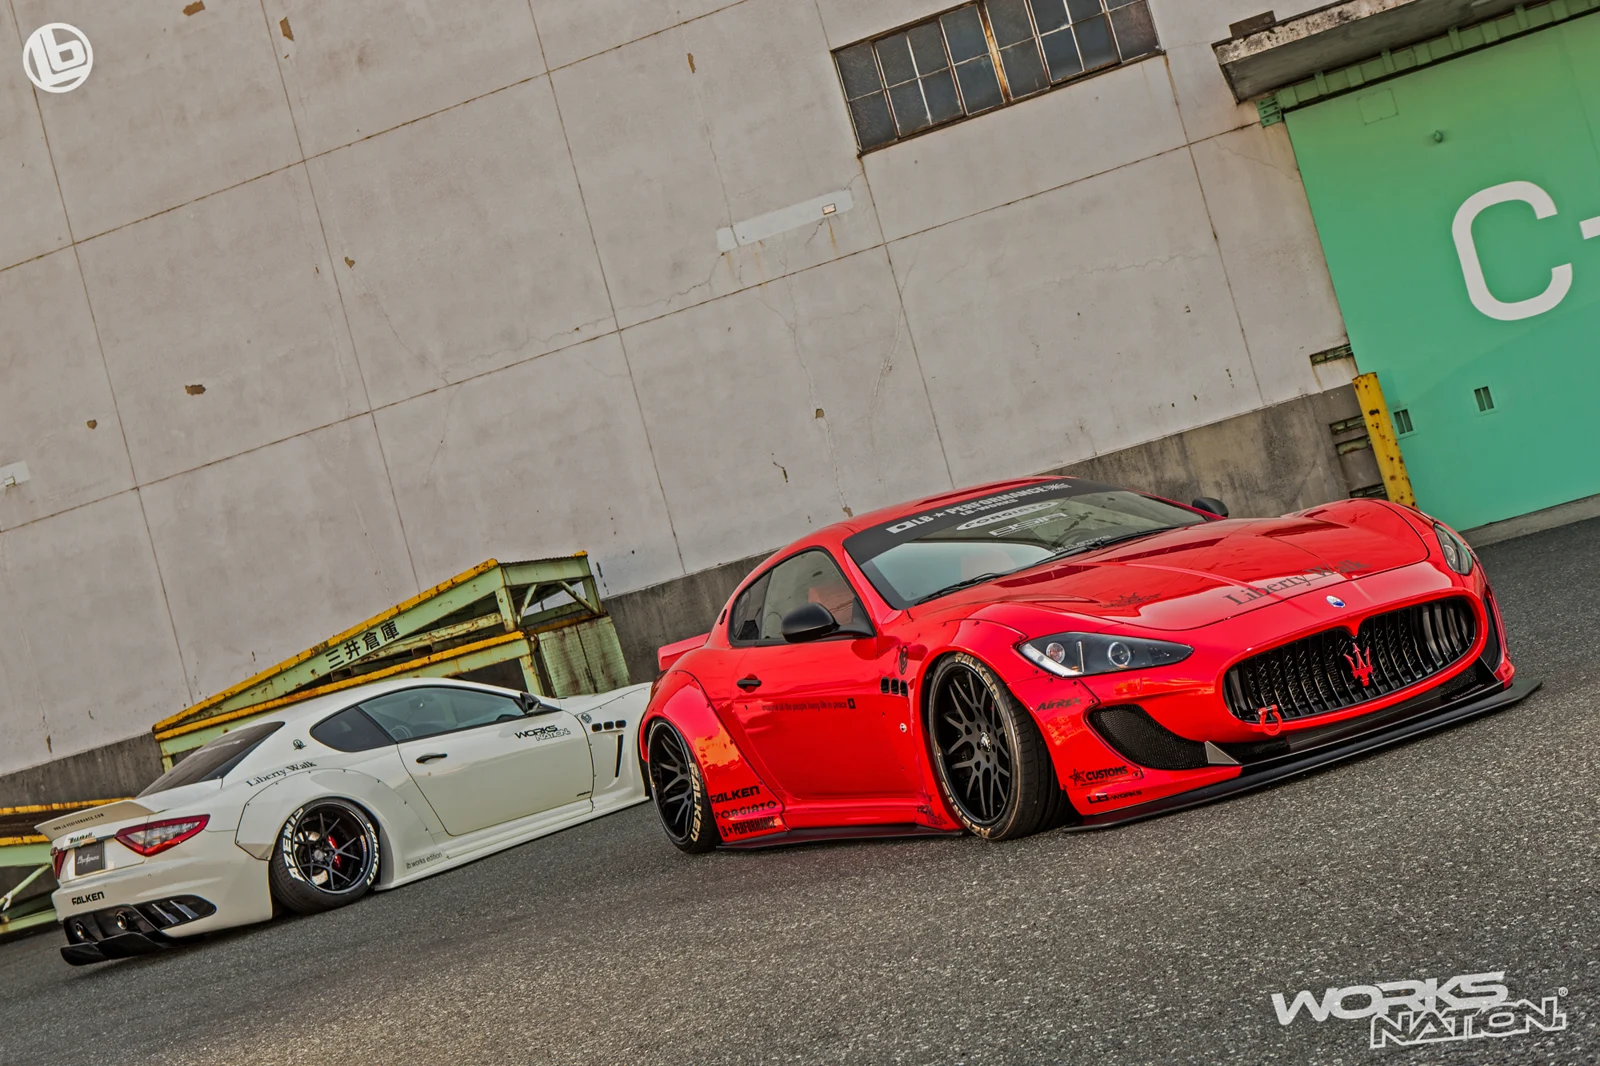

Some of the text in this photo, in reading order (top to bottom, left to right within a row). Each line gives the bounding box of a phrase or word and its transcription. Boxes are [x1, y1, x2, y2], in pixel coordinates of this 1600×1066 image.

[945, 486, 1047, 516] PERFORMANCE
[1223, 559, 1370, 606] Liberty Walk
[325, 620, 400, 670] 三井倉庫
[955, 652, 1000, 699] FALKEN
[514, 725, 558, 739] WORKS
[246, 761, 318, 787] Liberty Walk
[1085, 766, 1129, 780] CUSTOMS
[689, 761, 701, 842] FALKEN
[709, 785, 761, 804] FALKEN
[366, 822, 380, 886] FALKEN
[71, 891, 105, 906] FALKEN
